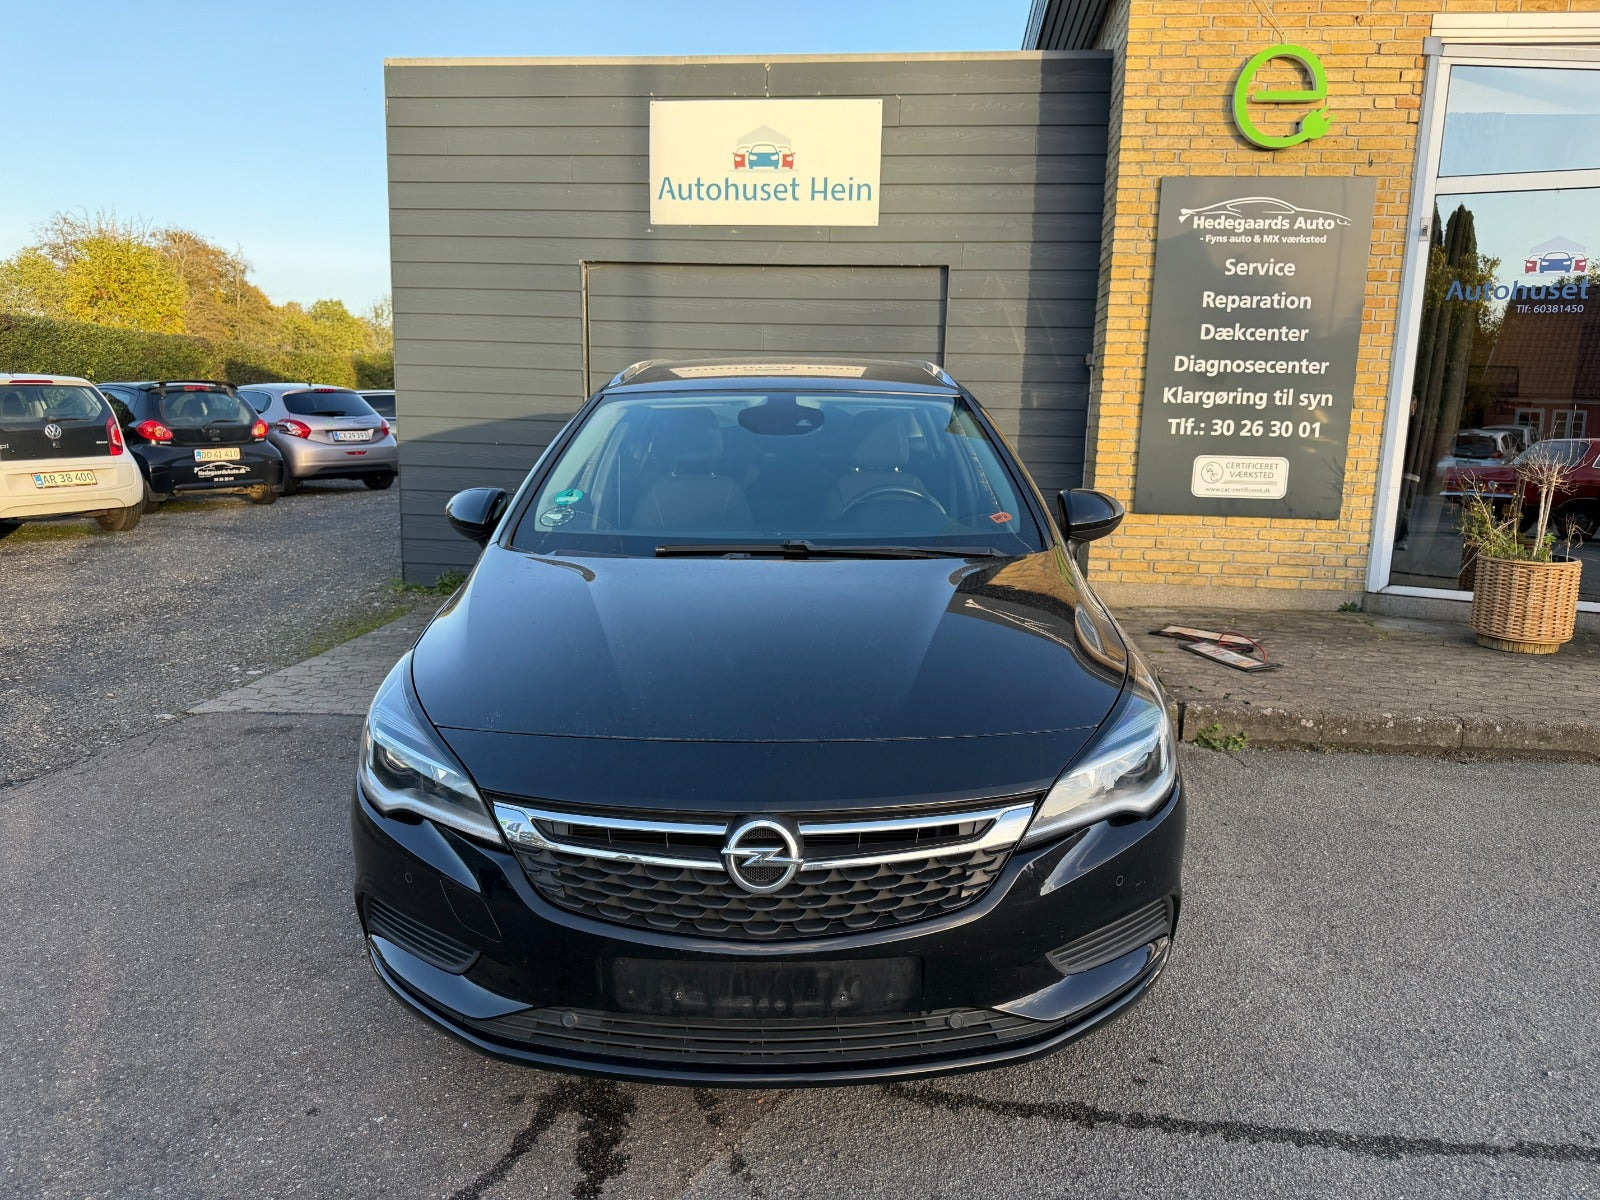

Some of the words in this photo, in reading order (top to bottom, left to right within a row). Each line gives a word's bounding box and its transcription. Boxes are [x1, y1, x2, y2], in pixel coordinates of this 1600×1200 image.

[658, 176, 800, 201] Autohuset
[810, 176, 872, 201] Hein
[1193, 216, 1290, 233] Hedegaards
[1294, 216, 1335, 230] Auto
[1205, 234, 1226, 244] Fyns
[1229, 235, 1251, 243] auto
[1253, 235, 1261, 243] &
[1263, 235, 1280, 243] MX
[1281, 235, 1327, 244] værksted
[1224, 258, 1296, 276] Service
[1445, 279, 1592, 301] Autohuset
[1202, 290, 1312, 312] Reparation
[1516, 304, 1531, 313] Tlf:
[1533, 304, 1584, 313] 60381450
[1200, 323, 1309, 342] Dækcenter
[1173, 355, 1330, 377] Diagnosecenter
[1163, 386, 1268, 408] Klargøring
[1273, 388, 1293, 406] til
[1299, 391, 1334, 410] syn
[1168, 418, 1205, 436] Tlf.:
[1211, 419, 1235, 436] 30
[1239, 420, 1264, 437] 26
[1269, 420, 1293, 438] 30
[1298, 421, 1321, 438] 01
[224, 450, 239, 458] 410
[1225, 461, 1279, 470] CERTIFICERET
[43, 475, 57, 484] AR
[60, 473, 73, 483] 38
[75, 472, 94, 482] 400
[1229, 471, 1274, 479] VÆRKSTED
